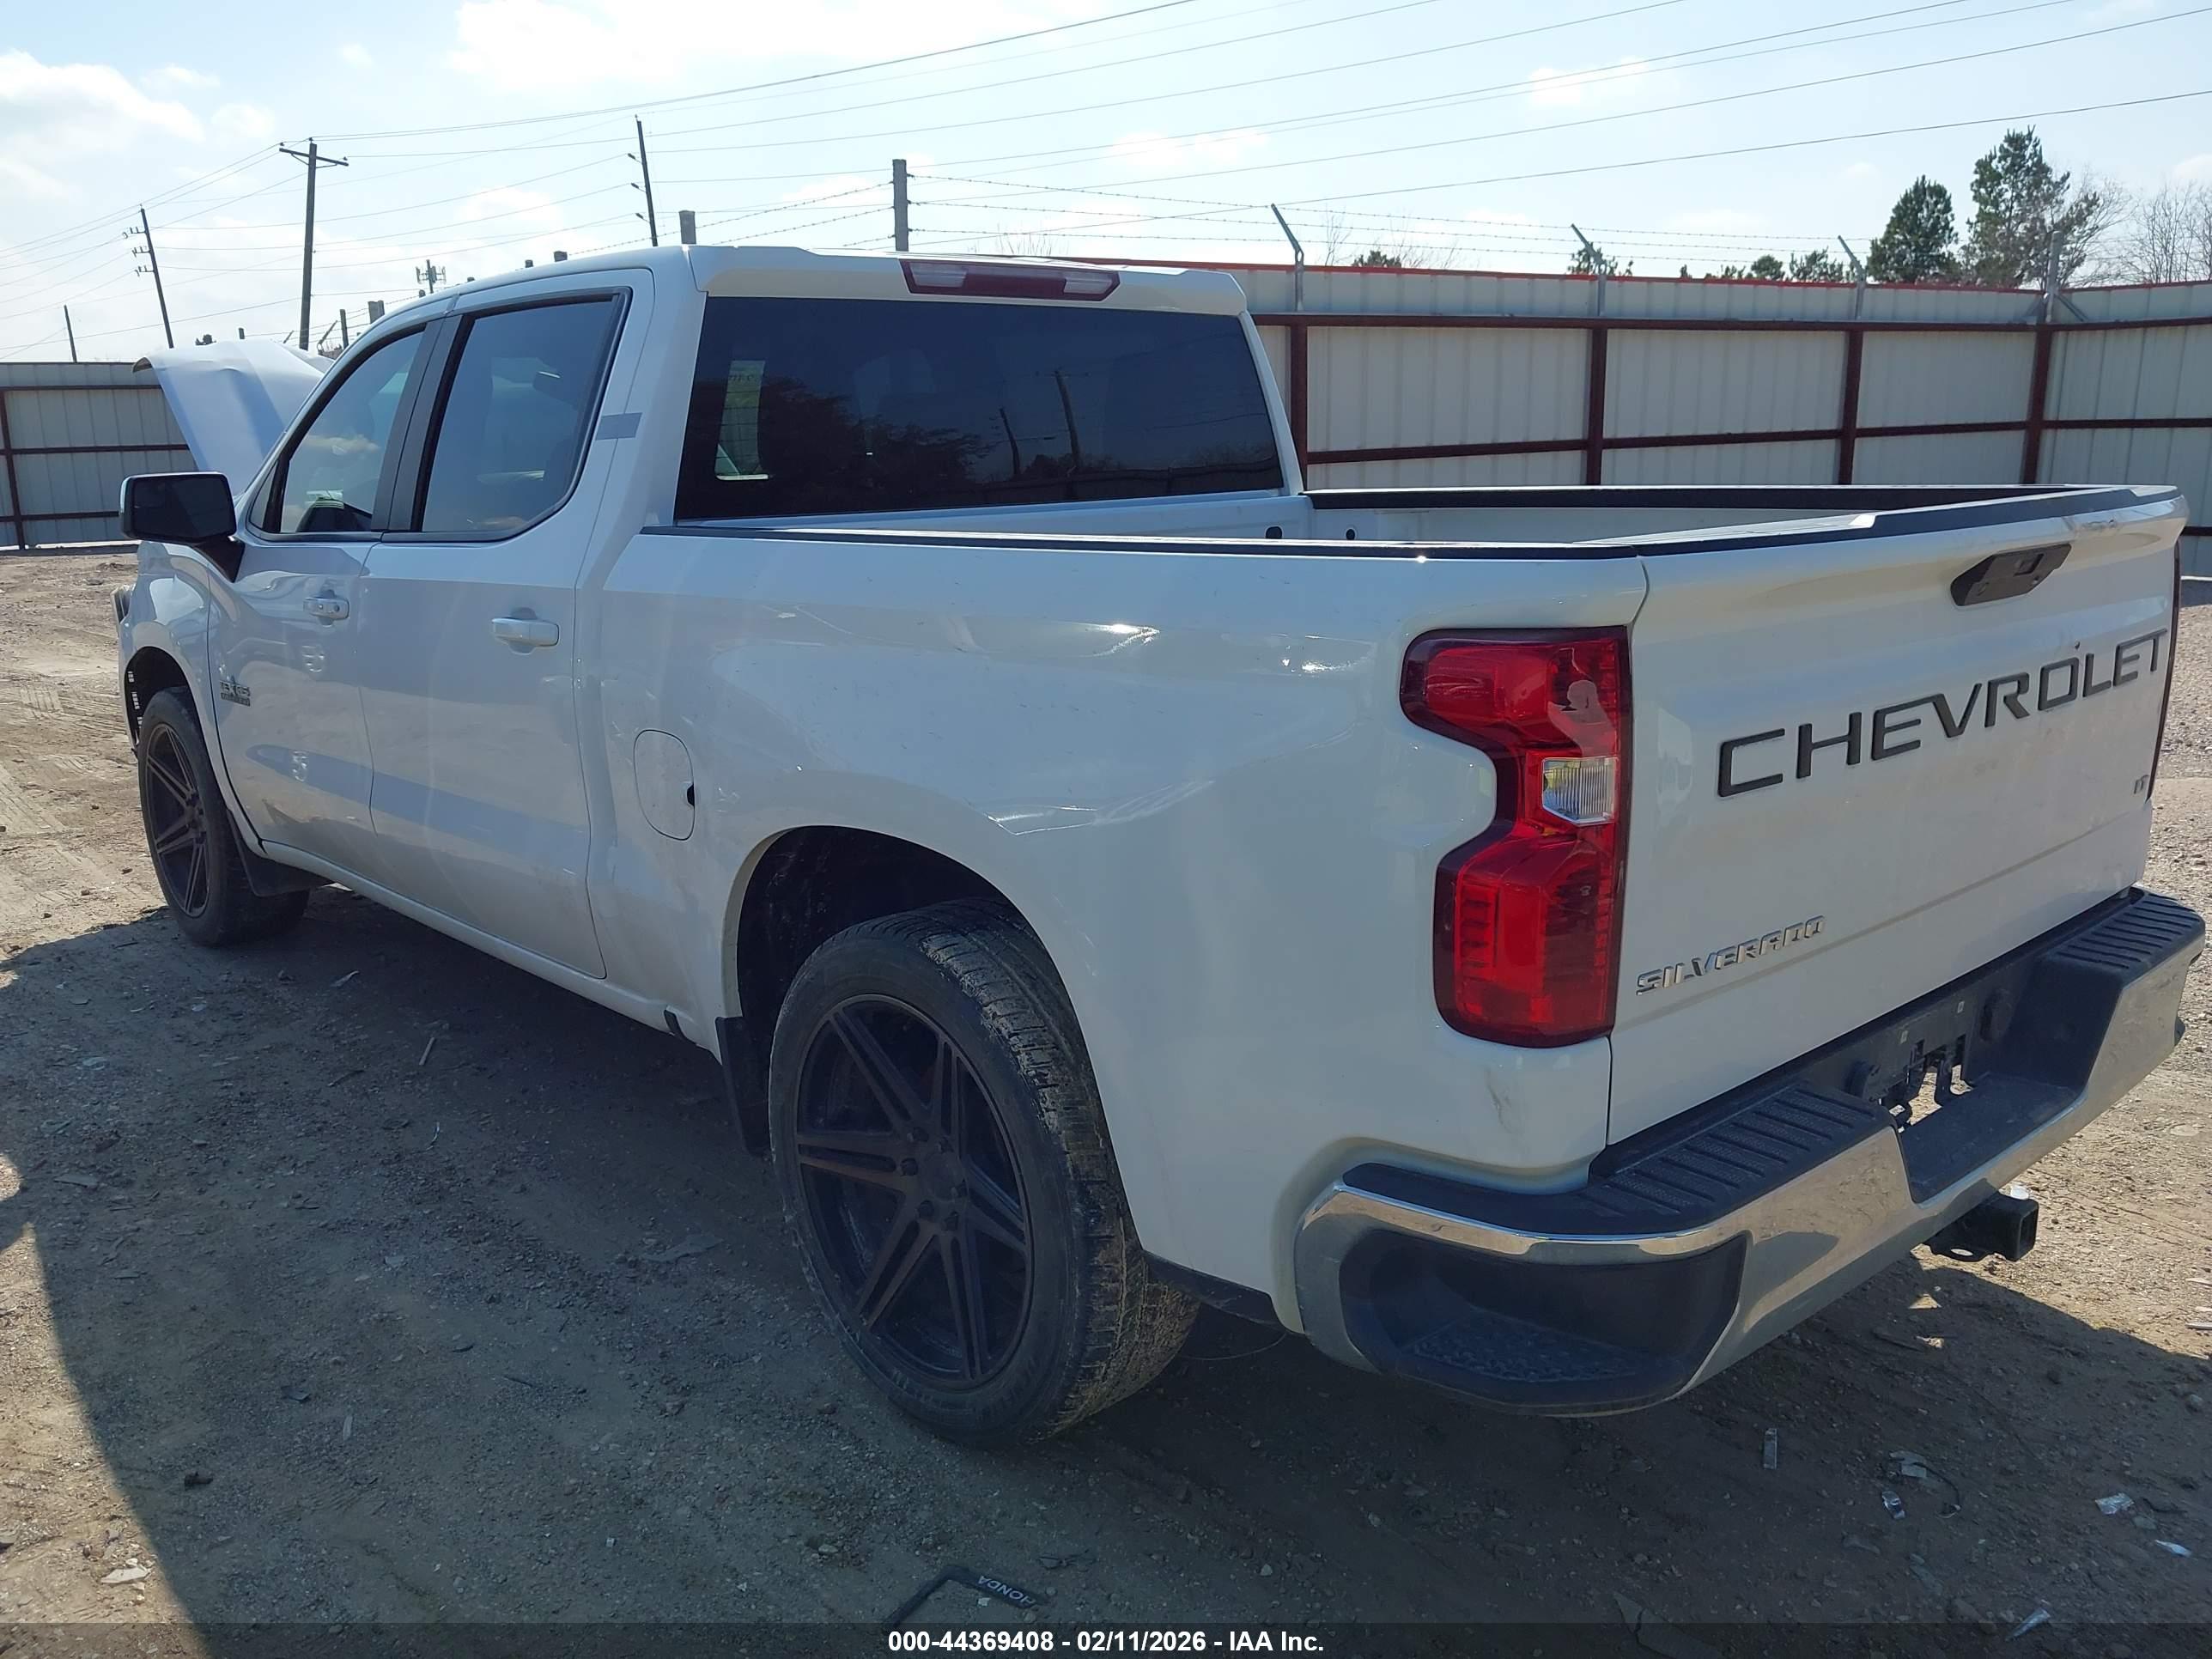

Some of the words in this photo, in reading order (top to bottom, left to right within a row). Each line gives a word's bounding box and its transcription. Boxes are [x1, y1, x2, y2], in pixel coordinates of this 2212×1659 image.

[1717, 628, 2167, 797] CHEVROLET
[1636, 915, 1826, 995] SILVERADO
[978, 1575, 1036, 1604] HONDA
